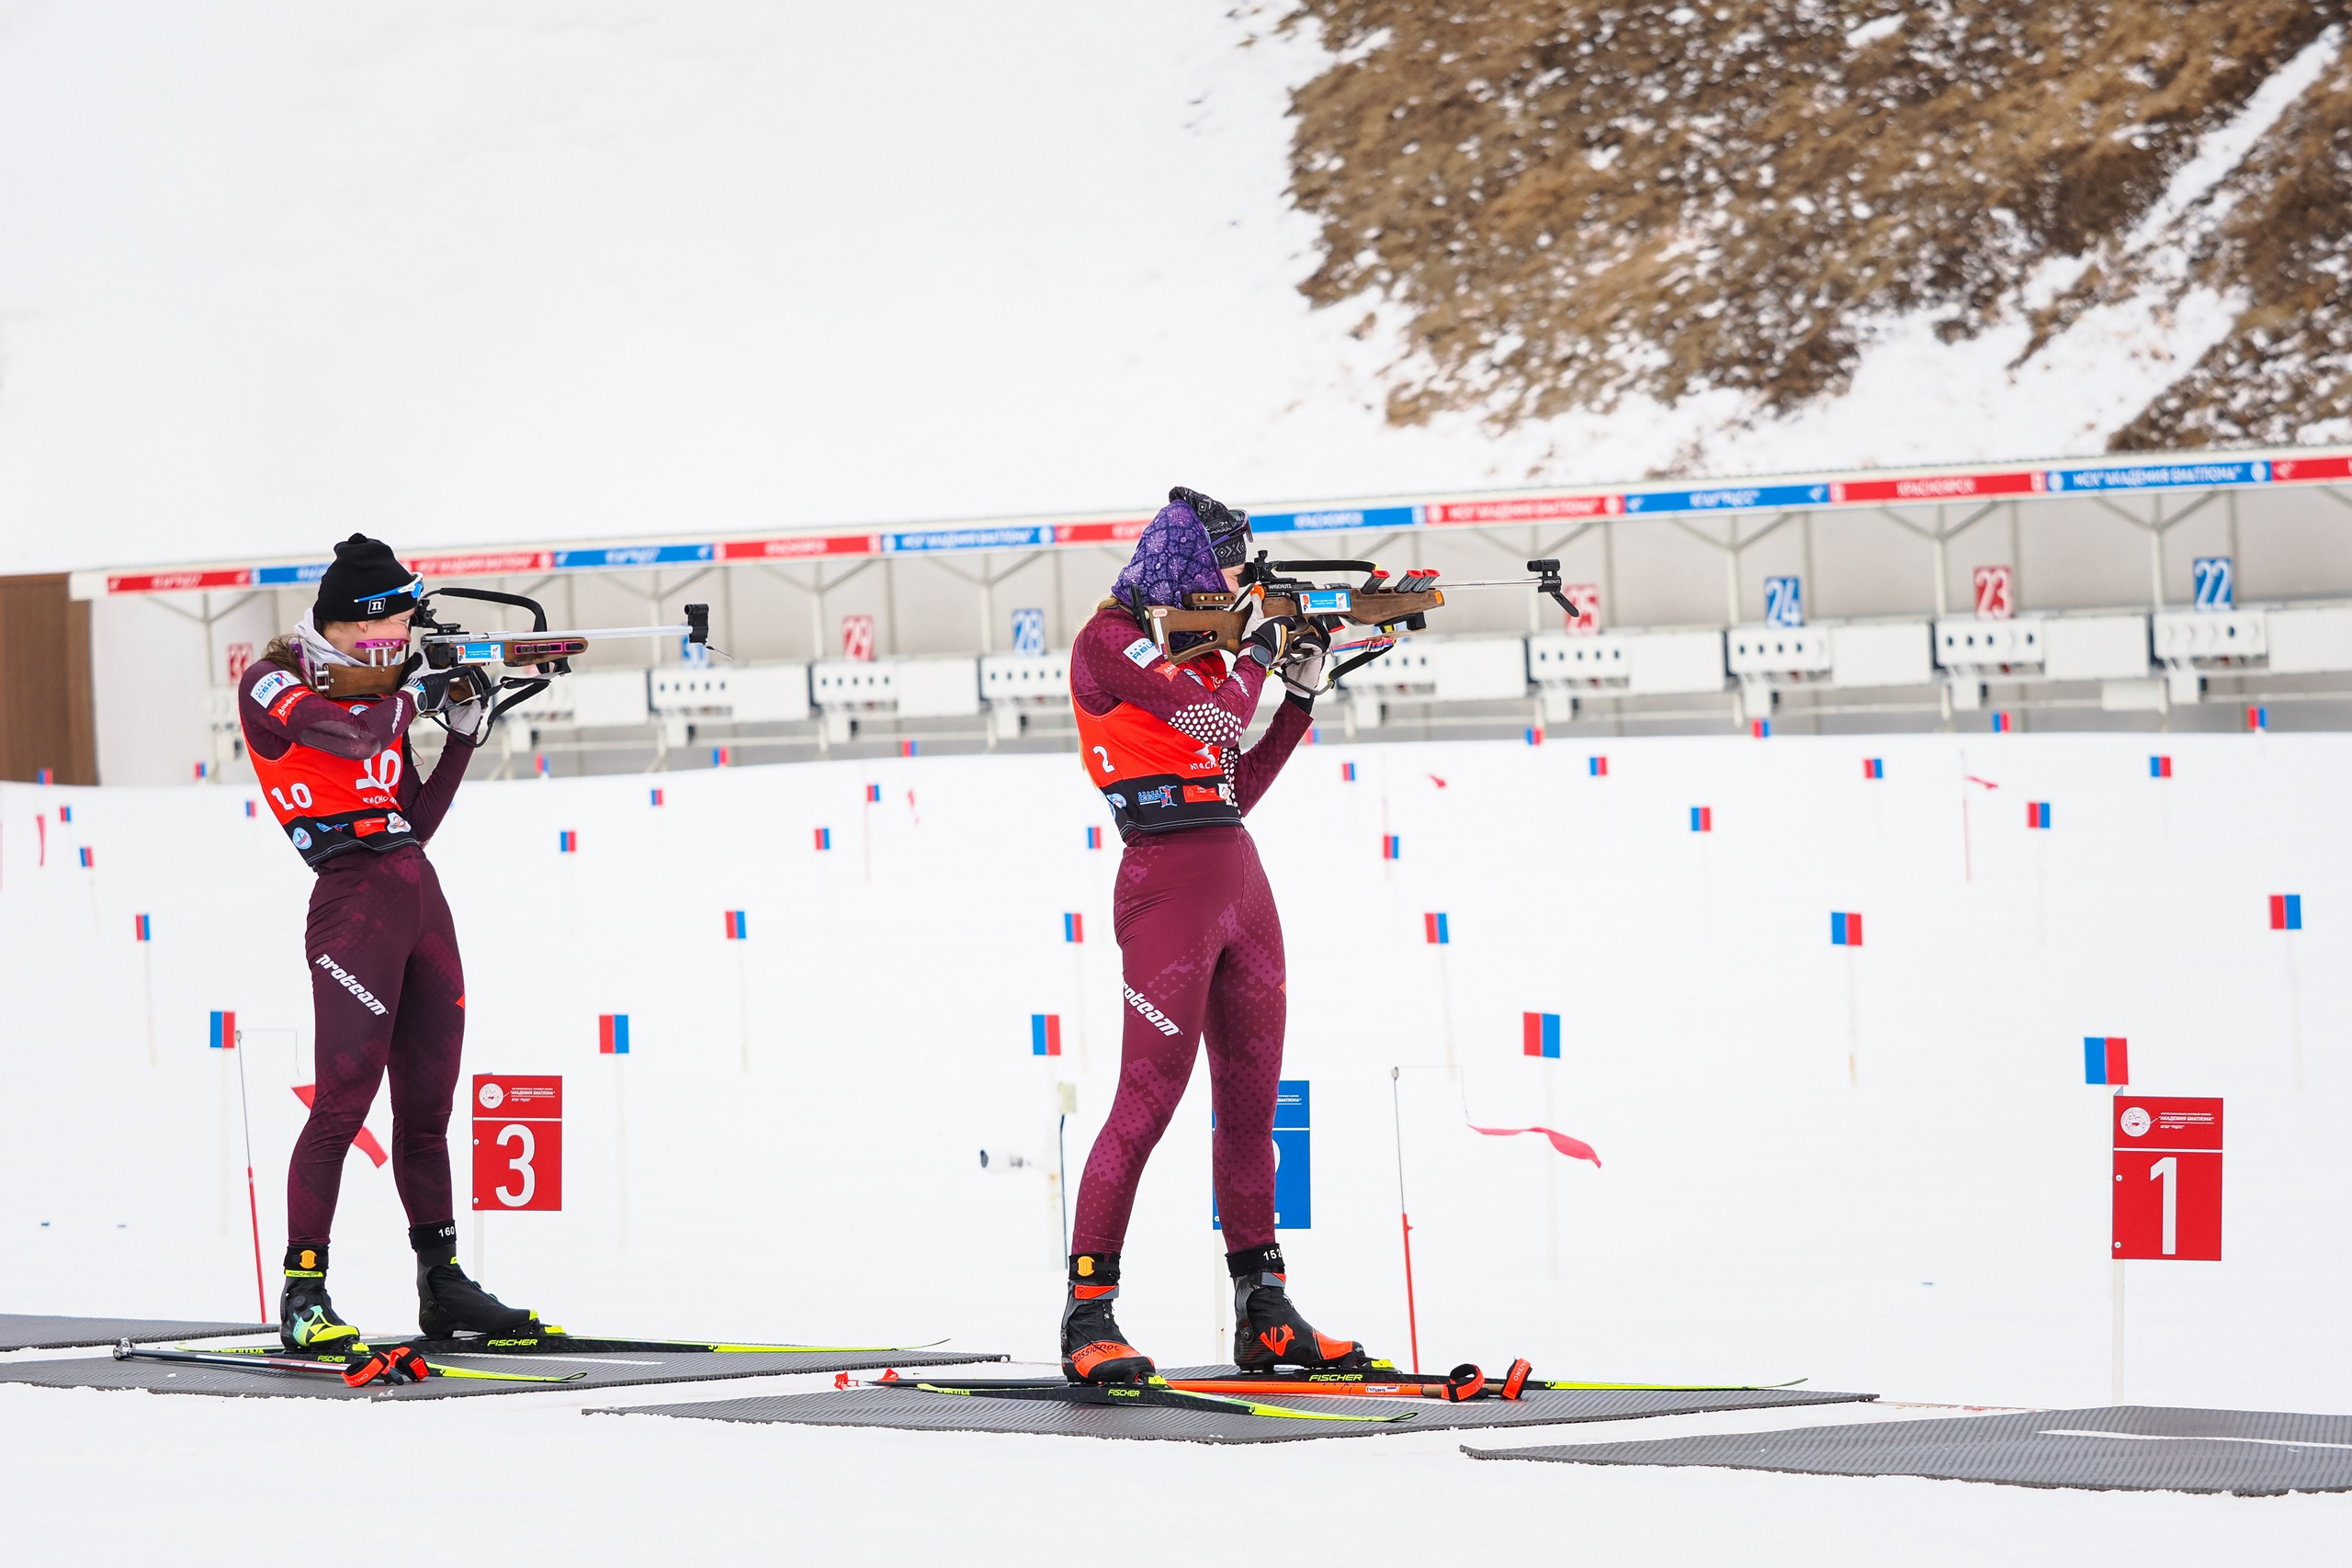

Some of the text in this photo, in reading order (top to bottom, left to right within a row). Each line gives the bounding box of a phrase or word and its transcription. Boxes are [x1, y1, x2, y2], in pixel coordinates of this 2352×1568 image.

[1765, 579, 1801, 627] 24
[1975, 570, 2011, 619] 23
[2195, 560, 2231, 610] 22
[843, 616, 874, 661] 29
[1012, 609, 1046, 657] 28
[1092, 746, 1115, 773] 2
[271, 783, 313, 811] 10
[495, 1123, 537, 1208] 3
[2150, 1156, 2177, 1256] 1
[438, 1225, 456, 1238] 160
[317, 1355, 346, 1363] FISCHER
[487, 1338, 538, 1347] FISCHER
[1107, 1388, 1140, 1397] FISCHER
[1308, 1373, 1363, 1382] FISCHER
